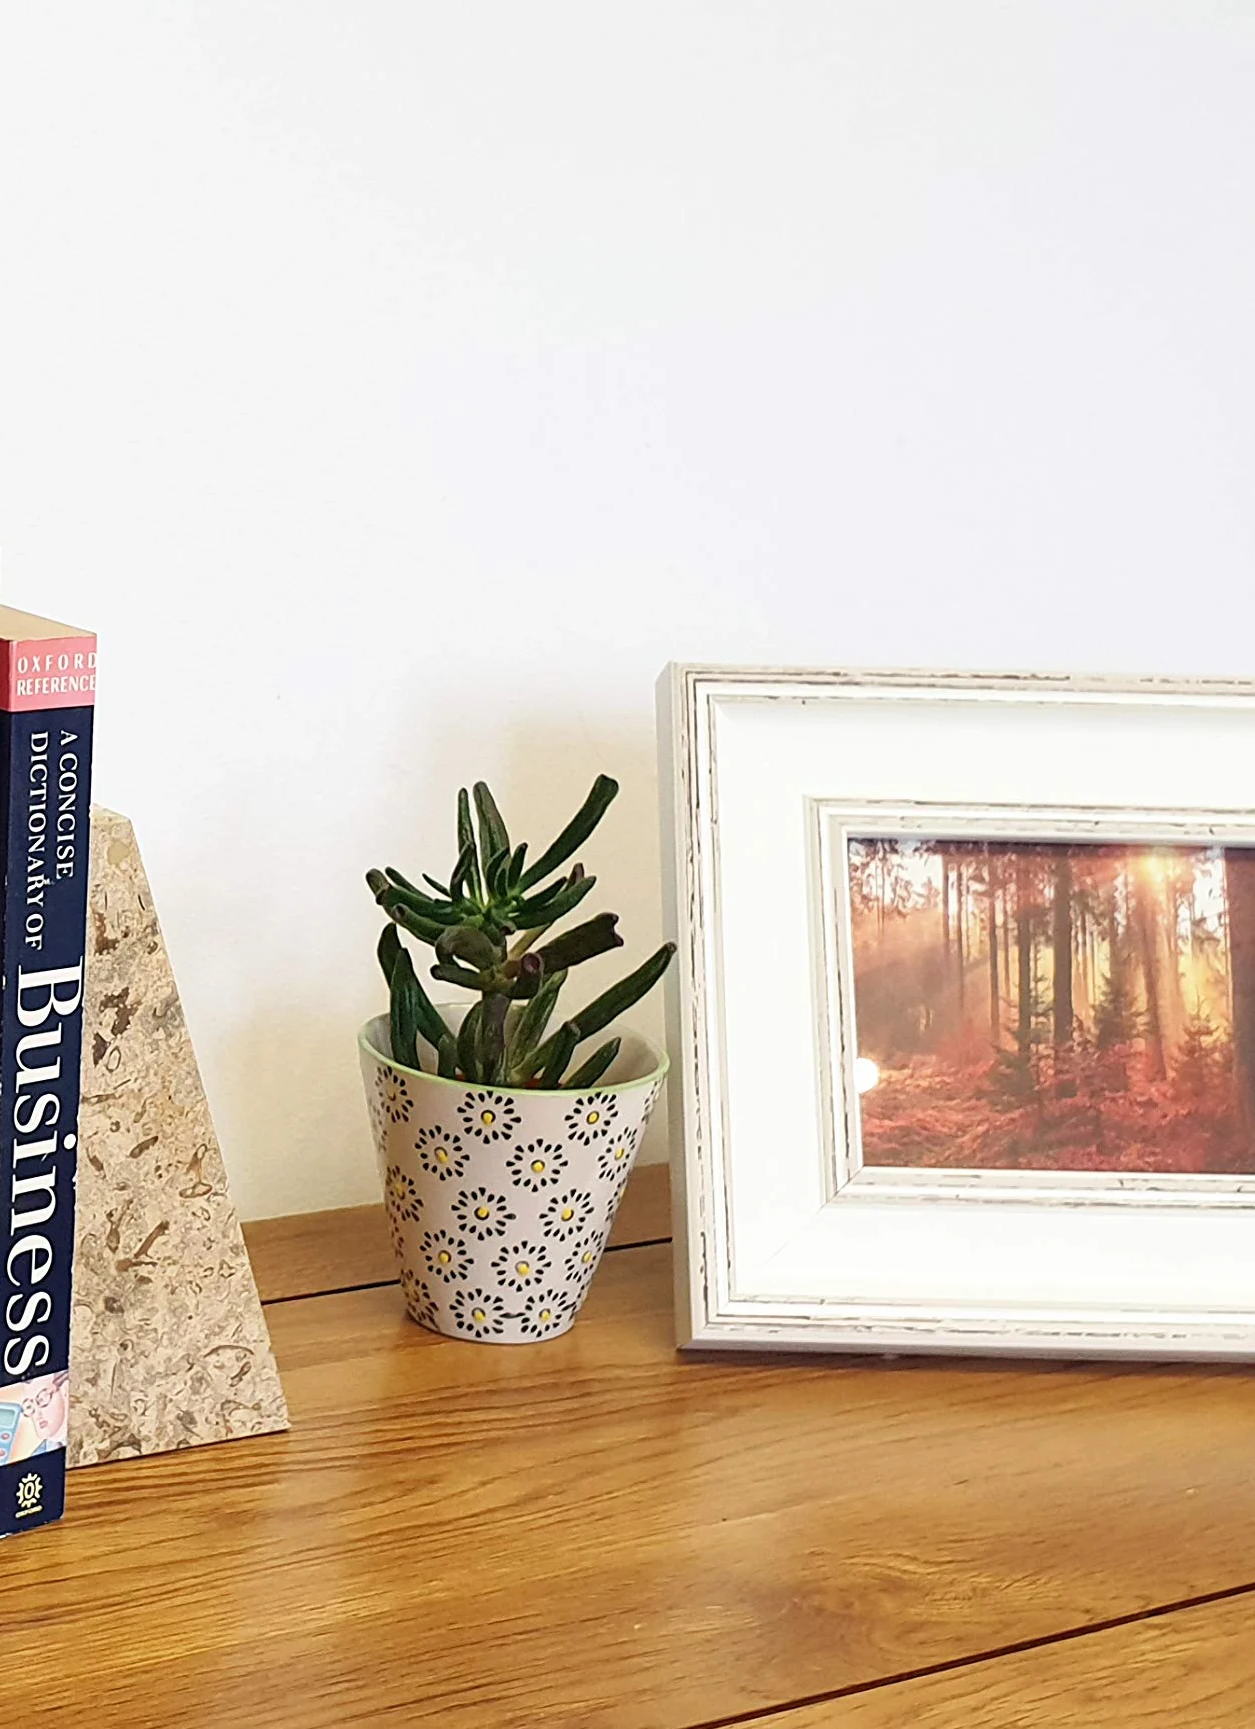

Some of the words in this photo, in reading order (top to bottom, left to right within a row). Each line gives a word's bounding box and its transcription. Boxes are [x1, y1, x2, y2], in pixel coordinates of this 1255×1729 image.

[17, 652, 97, 674] OXFORD
[17, 674, 96, 696] REFERENCE
[60, 729, 79, 746] A
[25, 731, 49, 910] DICTIONARY
[55, 755, 78, 880] CONCISE
[25, 914, 45, 951] OF
[3, 955, 84, 1376] Business
